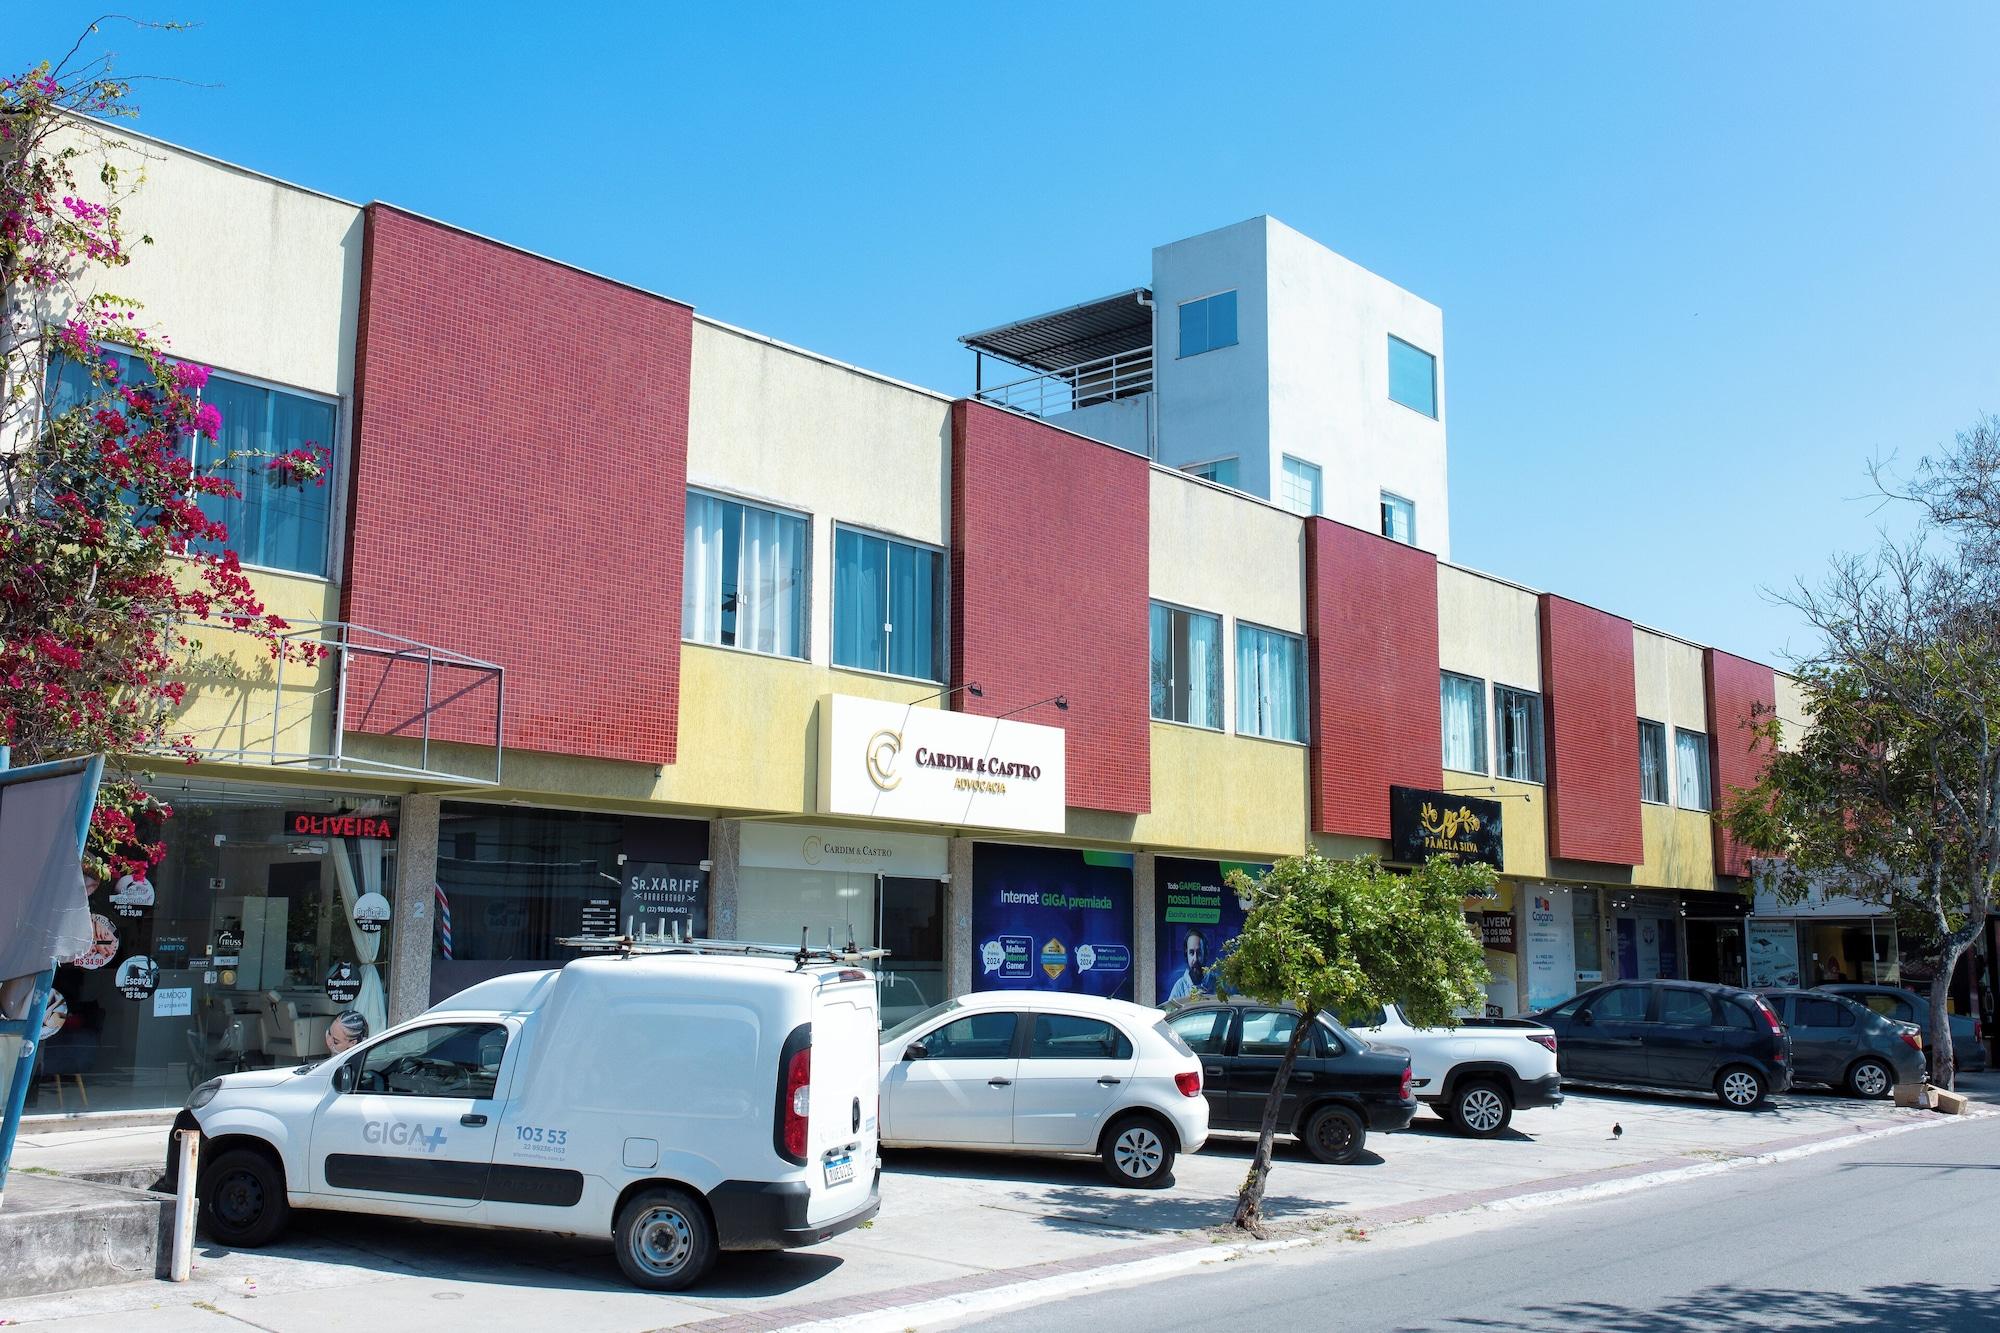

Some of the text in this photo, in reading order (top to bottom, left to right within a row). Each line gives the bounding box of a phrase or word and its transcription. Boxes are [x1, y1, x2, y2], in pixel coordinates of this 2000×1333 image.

[915, 747, 1042, 781] CARDIM & CASTRO
[954, 777, 1007, 794] ADVOCACIA
[295, 815, 391, 838] OLIVEIRA
[824, 843, 855, 855] CARDIM
[862, 846, 893, 857] CASTRO
[1459, 842, 1479, 853] SILVA
[1167, 882, 1179, 890] Todo
[1179, 881, 1200, 891] GAMER
[643, 892, 686, 902] BARBERSHOP
[1000, 890, 1112, 910] Internet GIGA premiada
[1167, 894, 1221, 906] nossa internet
[413, 901, 425, 918] 2
[1482, 917, 1511, 927] LIVERY
[1006, 944, 1026, 953] Melhor
[987, 957, 1000, 965] 2024
[1005, 953, 1028, 961] Internet
[1080, 958, 1091, 966] 2024
[1006, 962, 1025, 970] Gamer
[125, 975, 151, 985] Escova
[159, 991, 187, 1000] ALMOÇO
[517, 1126, 567, 1145] 103 53
